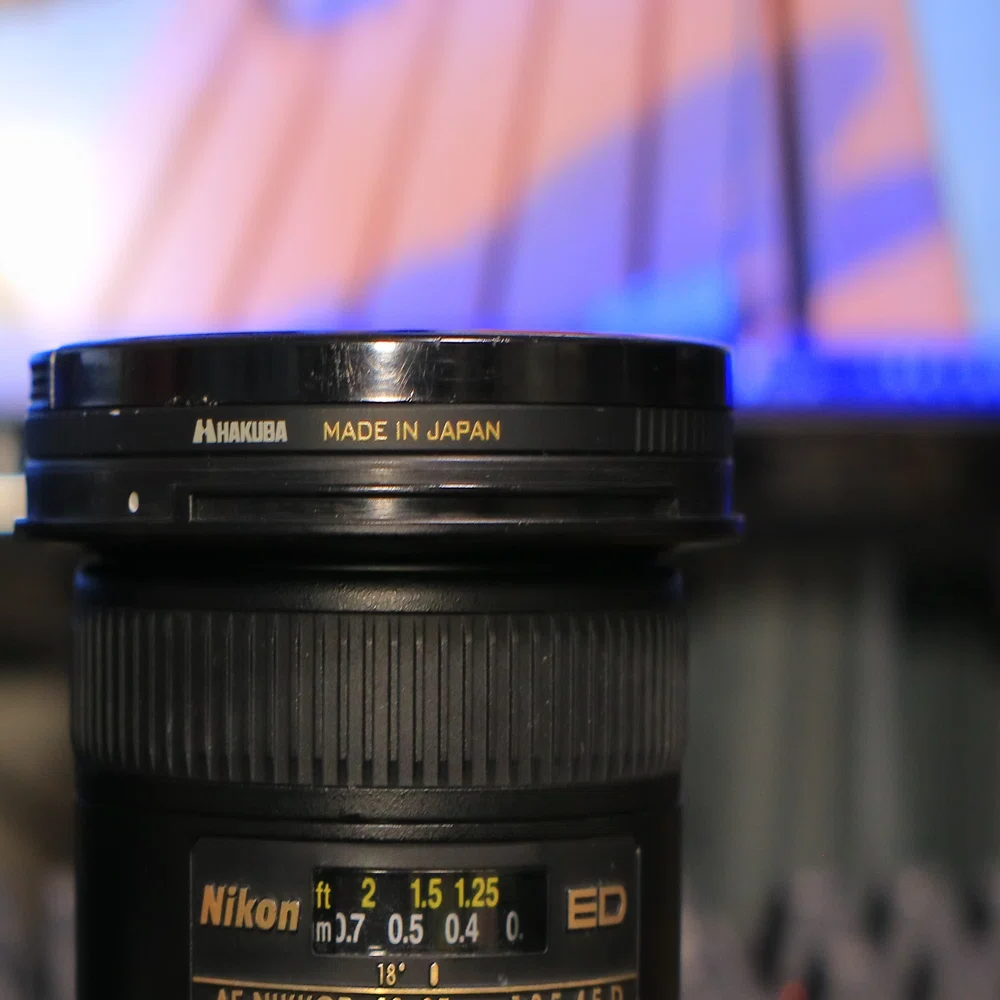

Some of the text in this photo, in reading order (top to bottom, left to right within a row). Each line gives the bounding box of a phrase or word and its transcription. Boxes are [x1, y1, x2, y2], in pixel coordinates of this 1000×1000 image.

[217, 420, 288, 443] HAKUBA
[322, 421, 501, 441] MADE IN JAPAN
[200, 884, 301, 932] Nikon
[315, 877, 499, 909] ft 2 1.5 1.25
[567, 885, 627, 930] ED
[316, 921, 332, 943] m
[388, 914, 424, 944] 0.5
[445, 914, 480, 944] 0.4
